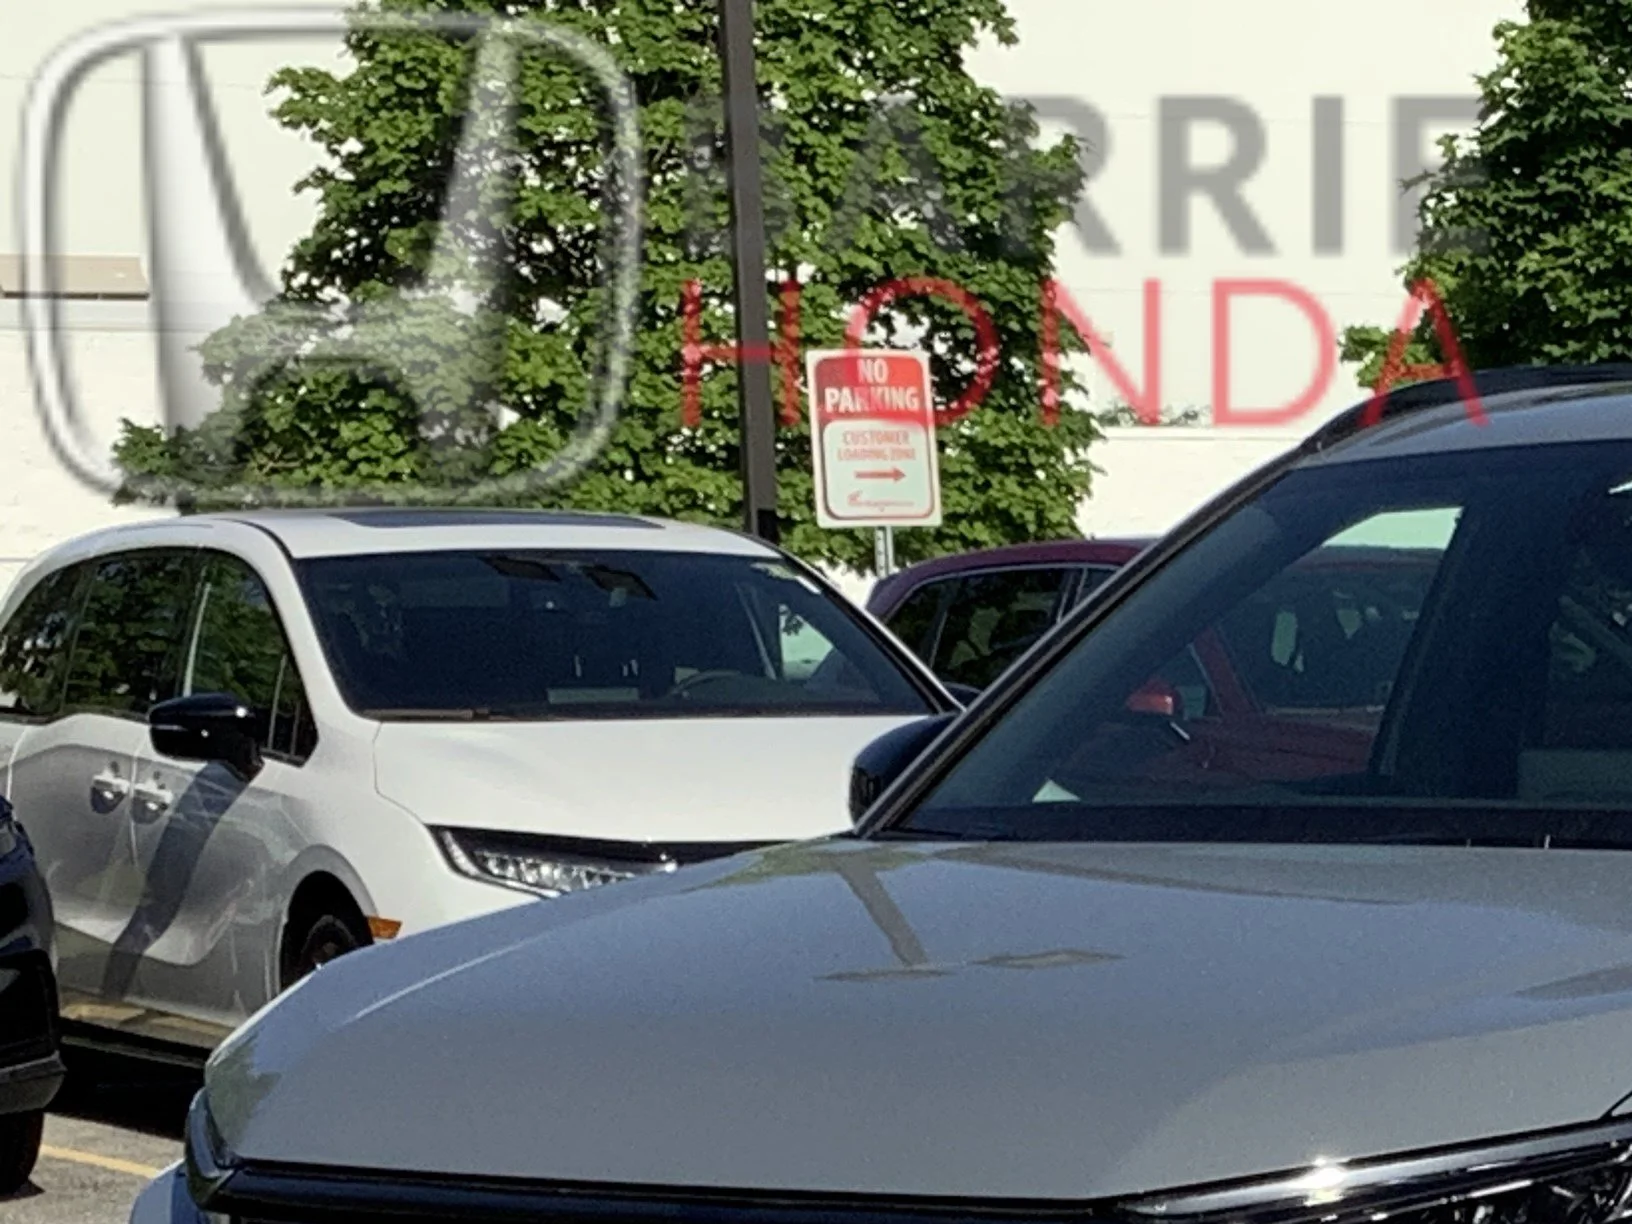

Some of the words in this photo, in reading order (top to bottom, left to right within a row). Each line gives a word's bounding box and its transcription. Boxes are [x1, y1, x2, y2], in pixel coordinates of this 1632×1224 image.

[857, 358, 889, 384] NO
[824, 386, 920, 413] PARKING
[842, 430, 910, 446] CUSTOMER
